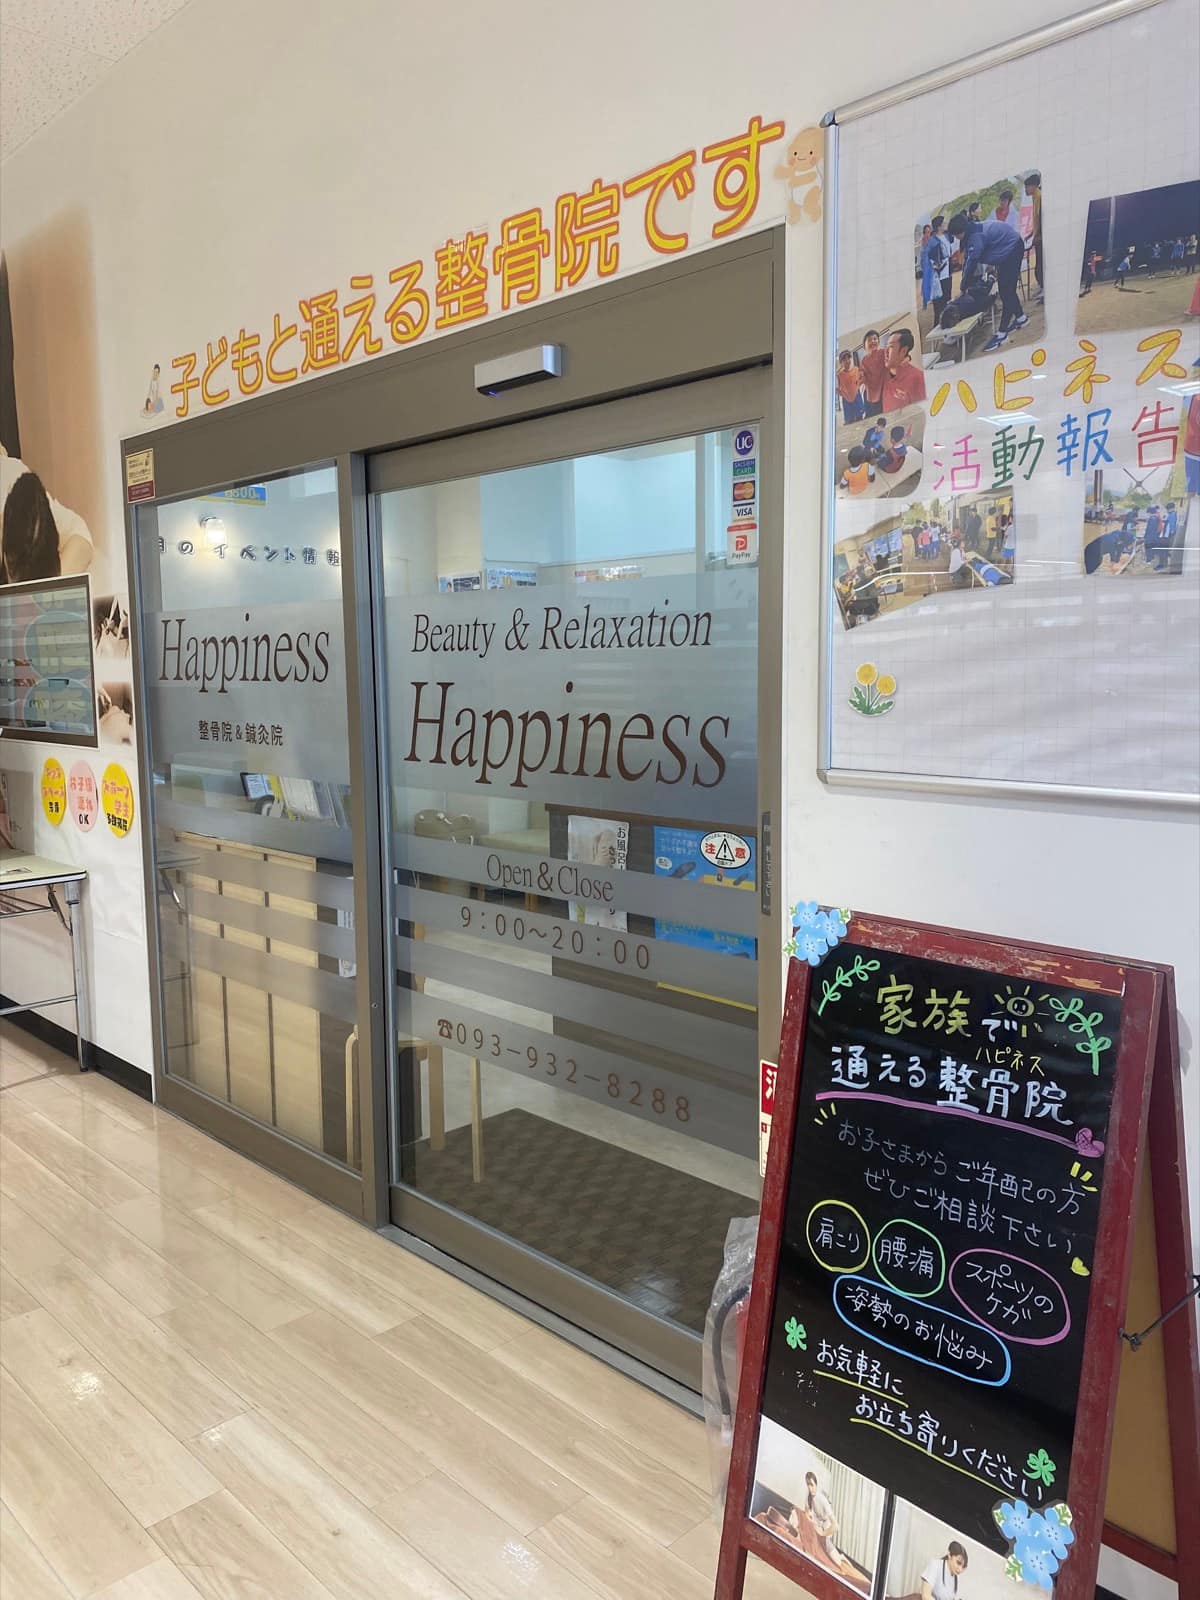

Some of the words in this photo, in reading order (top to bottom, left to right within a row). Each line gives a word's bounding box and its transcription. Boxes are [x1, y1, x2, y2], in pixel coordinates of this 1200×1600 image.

[171, 116, 784, 417] 子どもと通える整骨院です
[930, 329, 1187, 416] ハピネス
[736, 435, 753, 450] UC
[933, 401, 1180, 491] 活動報告
[736, 508, 753, 517] VISA
[732, 552, 751, 560] PayPay
[159, 612, 330, 693] Happiness
[411, 614, 496, 658] Beauty
[505, 607, 531, 651] &
[539, 599, 713, 650] Relaxation
[404, 681, 730, 788] Happiness
[79, 814, 89, 824] OK
[457, 1023, 690, 1122] 093-932-8288
[831, 1045, 1074, 1126] 通える整骨院
[976, 1046, 1046, 1077] ハピネス
[815, 1217, 860, 1252] 肩こり
[878, 1236, 934, 1278] 腰痛
[965, 1261, 1055, 1314] スポーツの
[986, 1292, 1032, 1325] ケガ
[845, 1286, 993, 1370] 姿勢のお悩み
[816, 1338, 905, 1396] お気軽に
[855, 1393, 1044, 1501] お立ち寄りください
